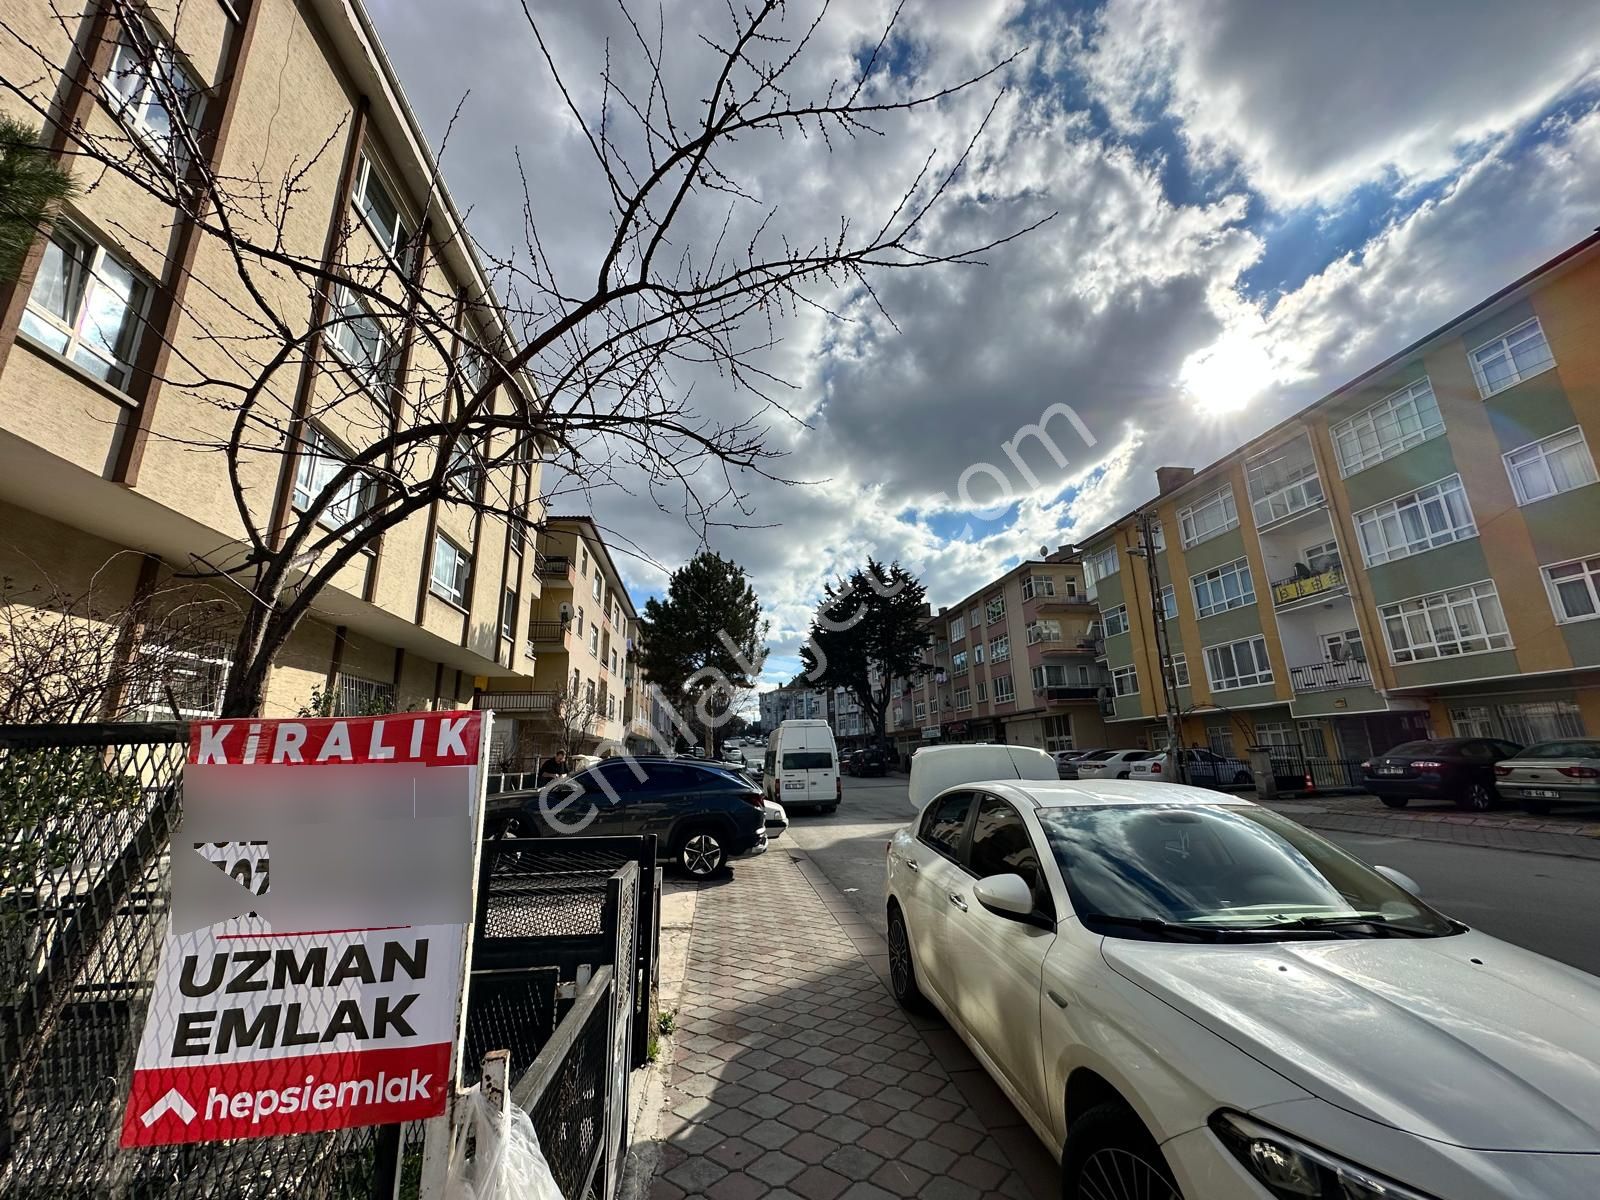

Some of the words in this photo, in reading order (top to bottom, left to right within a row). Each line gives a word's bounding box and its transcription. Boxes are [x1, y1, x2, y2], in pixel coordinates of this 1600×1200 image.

[179, 938, 429, 998] UZMAN
[171, 993, 417, 1058] EMLAK
[204, 1068, 433, 1122] hepsiemlak
